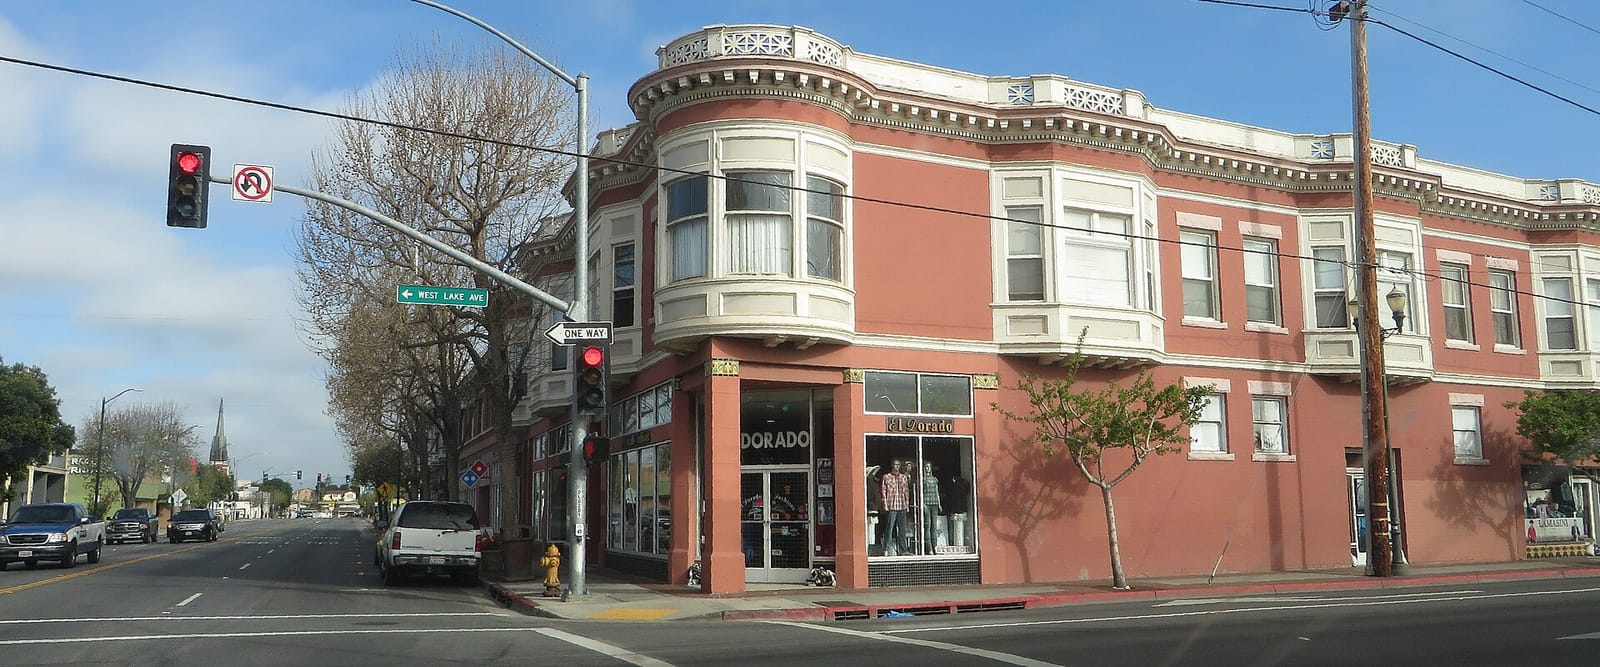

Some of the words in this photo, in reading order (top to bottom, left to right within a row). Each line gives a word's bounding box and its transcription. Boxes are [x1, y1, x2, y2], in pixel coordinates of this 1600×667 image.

[418, 291, 438, 299] WEST
[443, 292, 465, 300] LAKE
[469, 294, 484, 302] AVE
[564, 329, 583, 338] ONE
[585, 329, 604, 338] WAY
[888, 417, 903, 432] El
[906, 419, 953, 433] Dorado
[741, 430, 810, 449] DORADO
